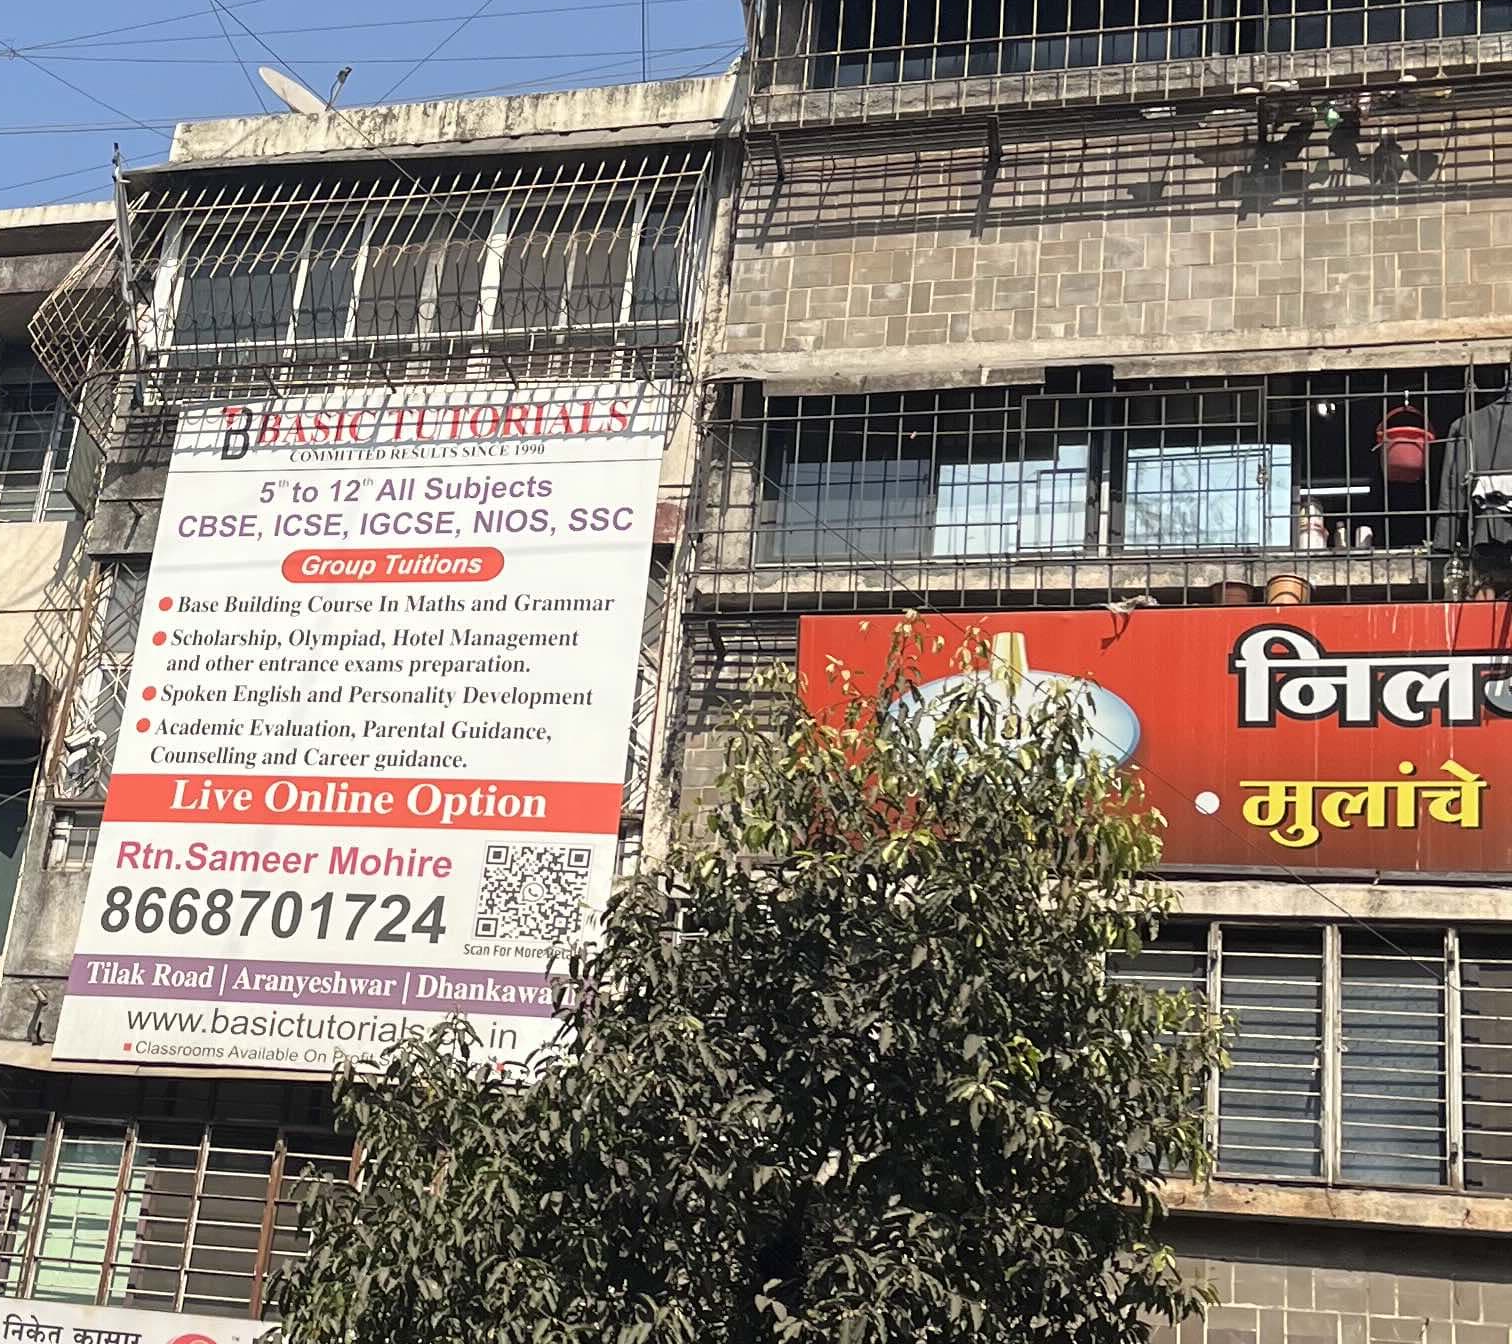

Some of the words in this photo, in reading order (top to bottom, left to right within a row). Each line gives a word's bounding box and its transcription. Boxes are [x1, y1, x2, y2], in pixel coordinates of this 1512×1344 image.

[257, 409, 377, 444] BASIC
[388, 400, 630, 443] TUTORIALS
[290, 447, 386, 463] COMMITTED
[389, 445, 458, 460] RESULTS
[462, 444, 509, 458] SINCE
[513, 443, 545, 456] 1990
[292, 483, 319, 503] to
[377, 477, 414, 501] All
[425, 475, 553, 505] Subjects
[178, 513, 263, 543] CBSE,
[274, 514, 349, 540] ICSE,
[360, 511, 461, 539] IGCSE,
[473, 508, 557, 537] NIOS,
[568, 507, 635, 532] SSC
[301, 555, 377, 579] Group
[384, 553, 483, 576] Tuitions
[178, 596, 219, 613] Base
[224, 595, 301, 617] Building
[308, 596, 373, 614] Course
[378, 596, 399, 613] In
[405, 595, 466, 613] Maths
[470, 594, 507, 612] and
[513, 594, 615, 613] Grammar
[170, 629, 282, 650] Scholarship,
[288, 629, 387, 651] Olympiad,
[393, 629, 445, 647] Hotel
[450, 629, 579, 650] Management
[166, 655, 200, 672] and
[205, 655, 255, 672] other
[258, 657, 339, 673] entrance
[344, 659, 403, 673] exams
[408, 657, 531, 677] preparation.
[1229, 624, 1512, 729] निल
[160, 686, 228, 706] Spoken
[233, 686, 302, 706] English
[307, 686, 342, 704] and
[348, 686, 456, 708] Personality
[462, 687, 593, 709] Development
[155, 720, 245, 737] Academic
[249, 720, 356, 740] Evaluation,
[362, 721, 446, 739] Parental
[451, 722, 552, 743] Guidance,
[150, 746, 257, 768] Counselling
[261, 747, 297, 765] and
[303, 749, 371, 767] Career
[374, 750, 468, 771] guidance.
[170, 779, 258, 812] Live
[264, 780, 395, 815] Online
[407, 783, 547, 824] Option
[1239, 760, 1488, 849] मुलांचे
[116, 840, 319, 874] Rtn.Sameer
[328, 846, 452, 878] Mohire
[100, 885, 448, 945] 8668701724
[464, 944, 489, 956] Scan
[493, 945, 512, 957] For
[515, 946, 544, 958] More
[87, 961, 146, 987] Tilak
[152, 965, 213, 990] Road
[232, 971, 397, 1000] Aranyeshwar
[135, 1041, 224, 1058] Classrooms
[228, 1045, 298, 1063] Available
[304, 1049, 326, 1063] On
[3, 1314, 64, 1344] निकेत
